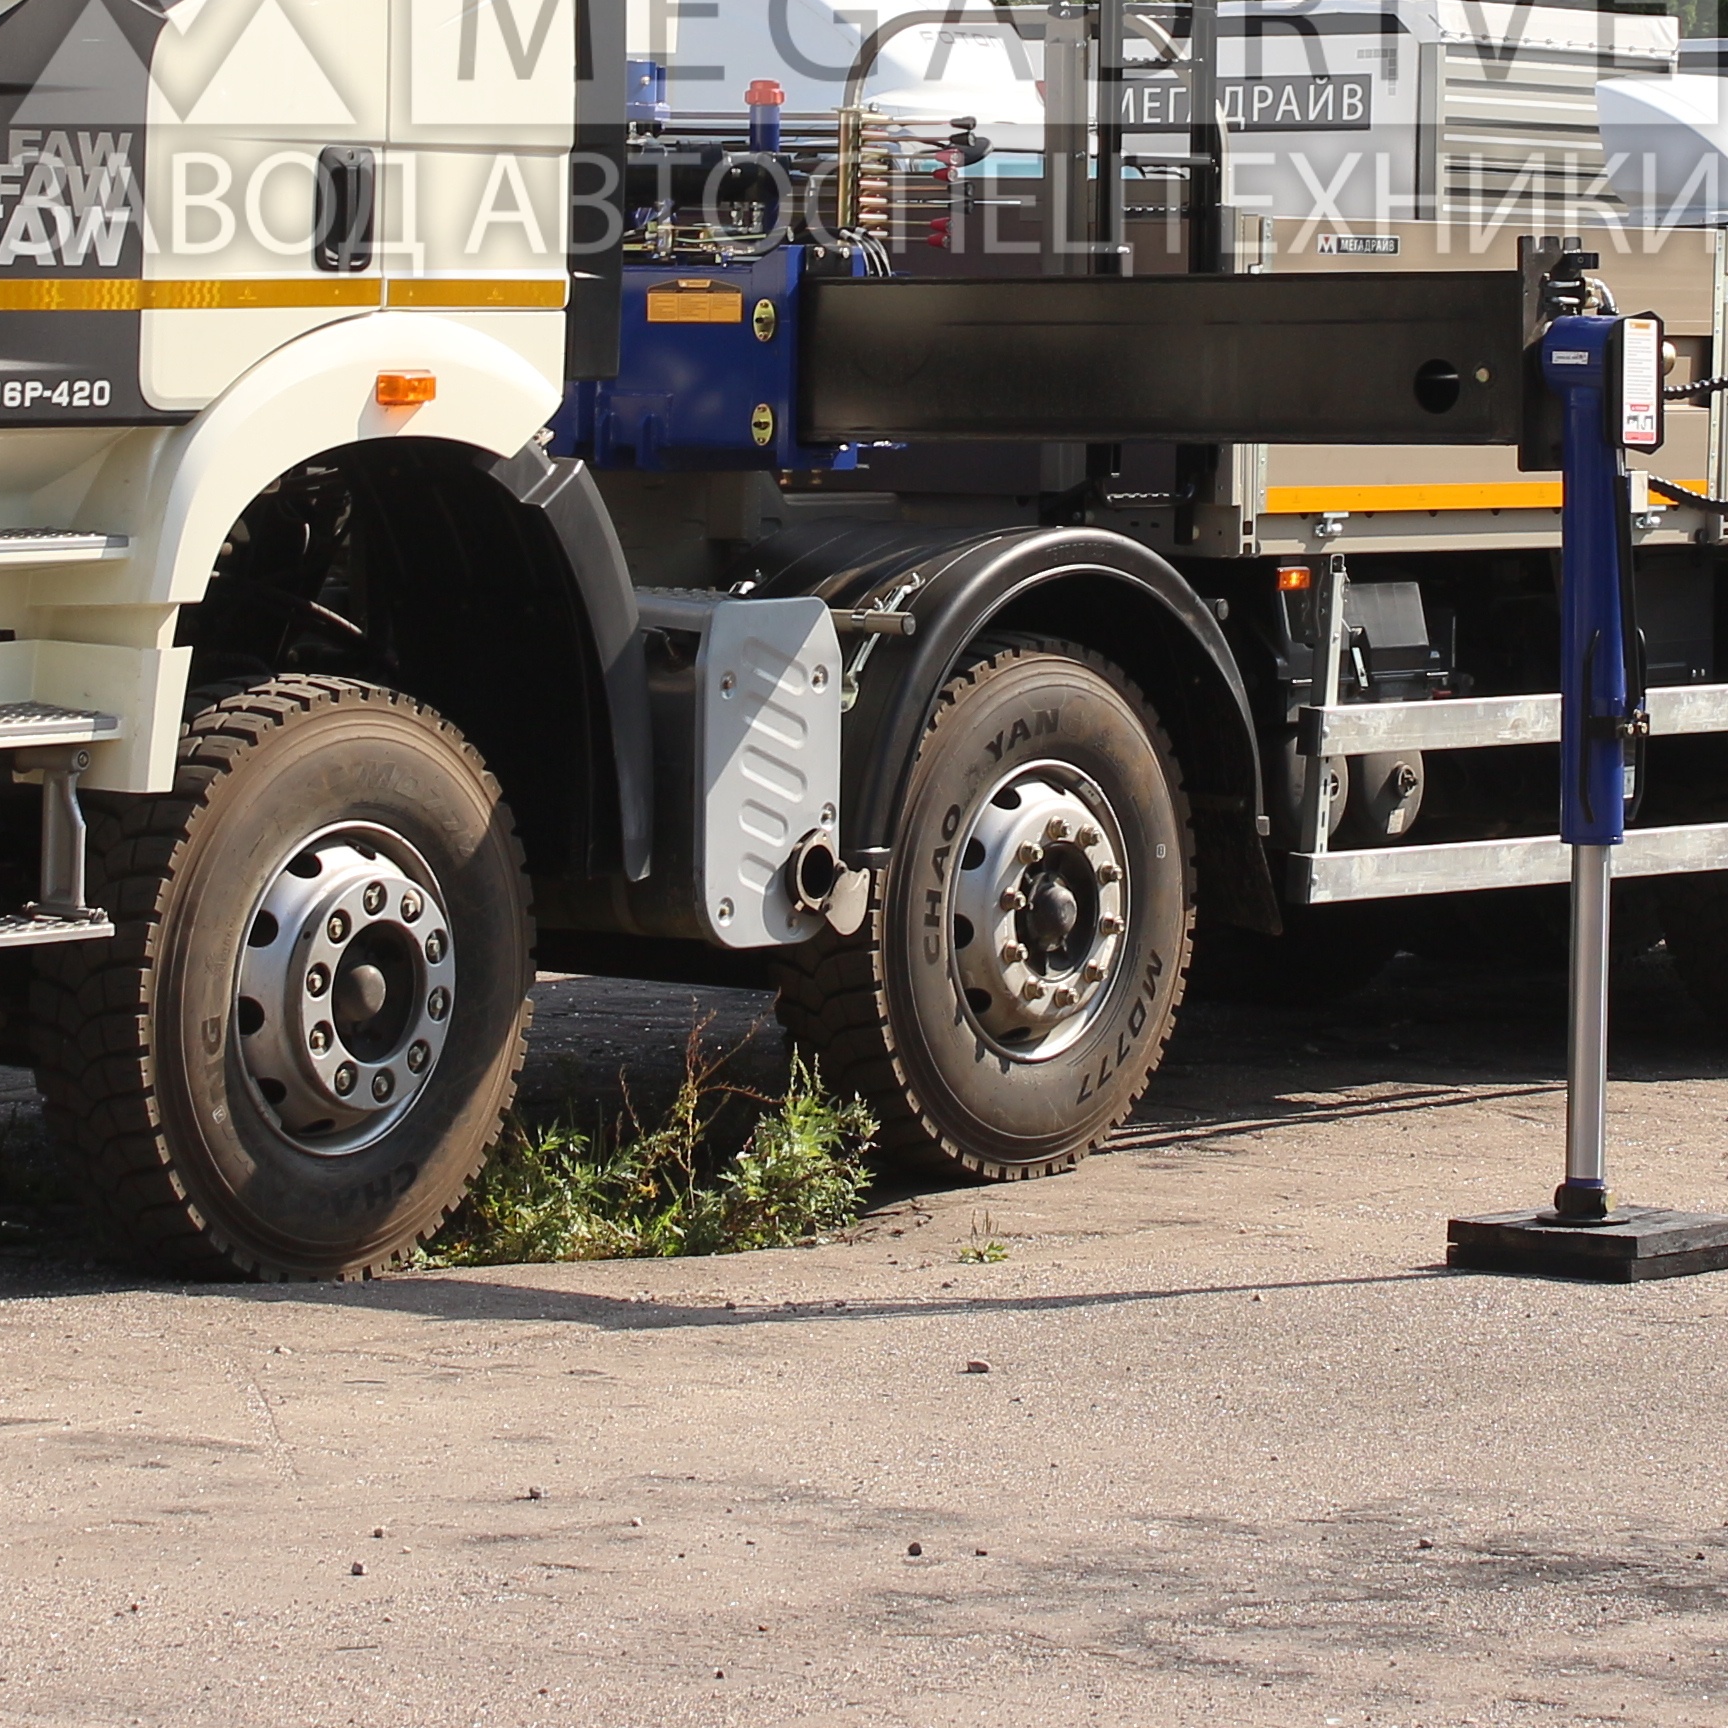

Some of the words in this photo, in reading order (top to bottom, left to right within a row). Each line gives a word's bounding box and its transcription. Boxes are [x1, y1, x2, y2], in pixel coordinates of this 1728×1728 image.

[1121, 76, 1365, 130] ЕГДРАЙВ
[9, 129, 133, 176] FAW
[1340, 238, 1395, 253] МЕГАДРАЙВ
[923, 803, 962, 966] CHAO
[1076, 948, 1164, 1107] MD777
